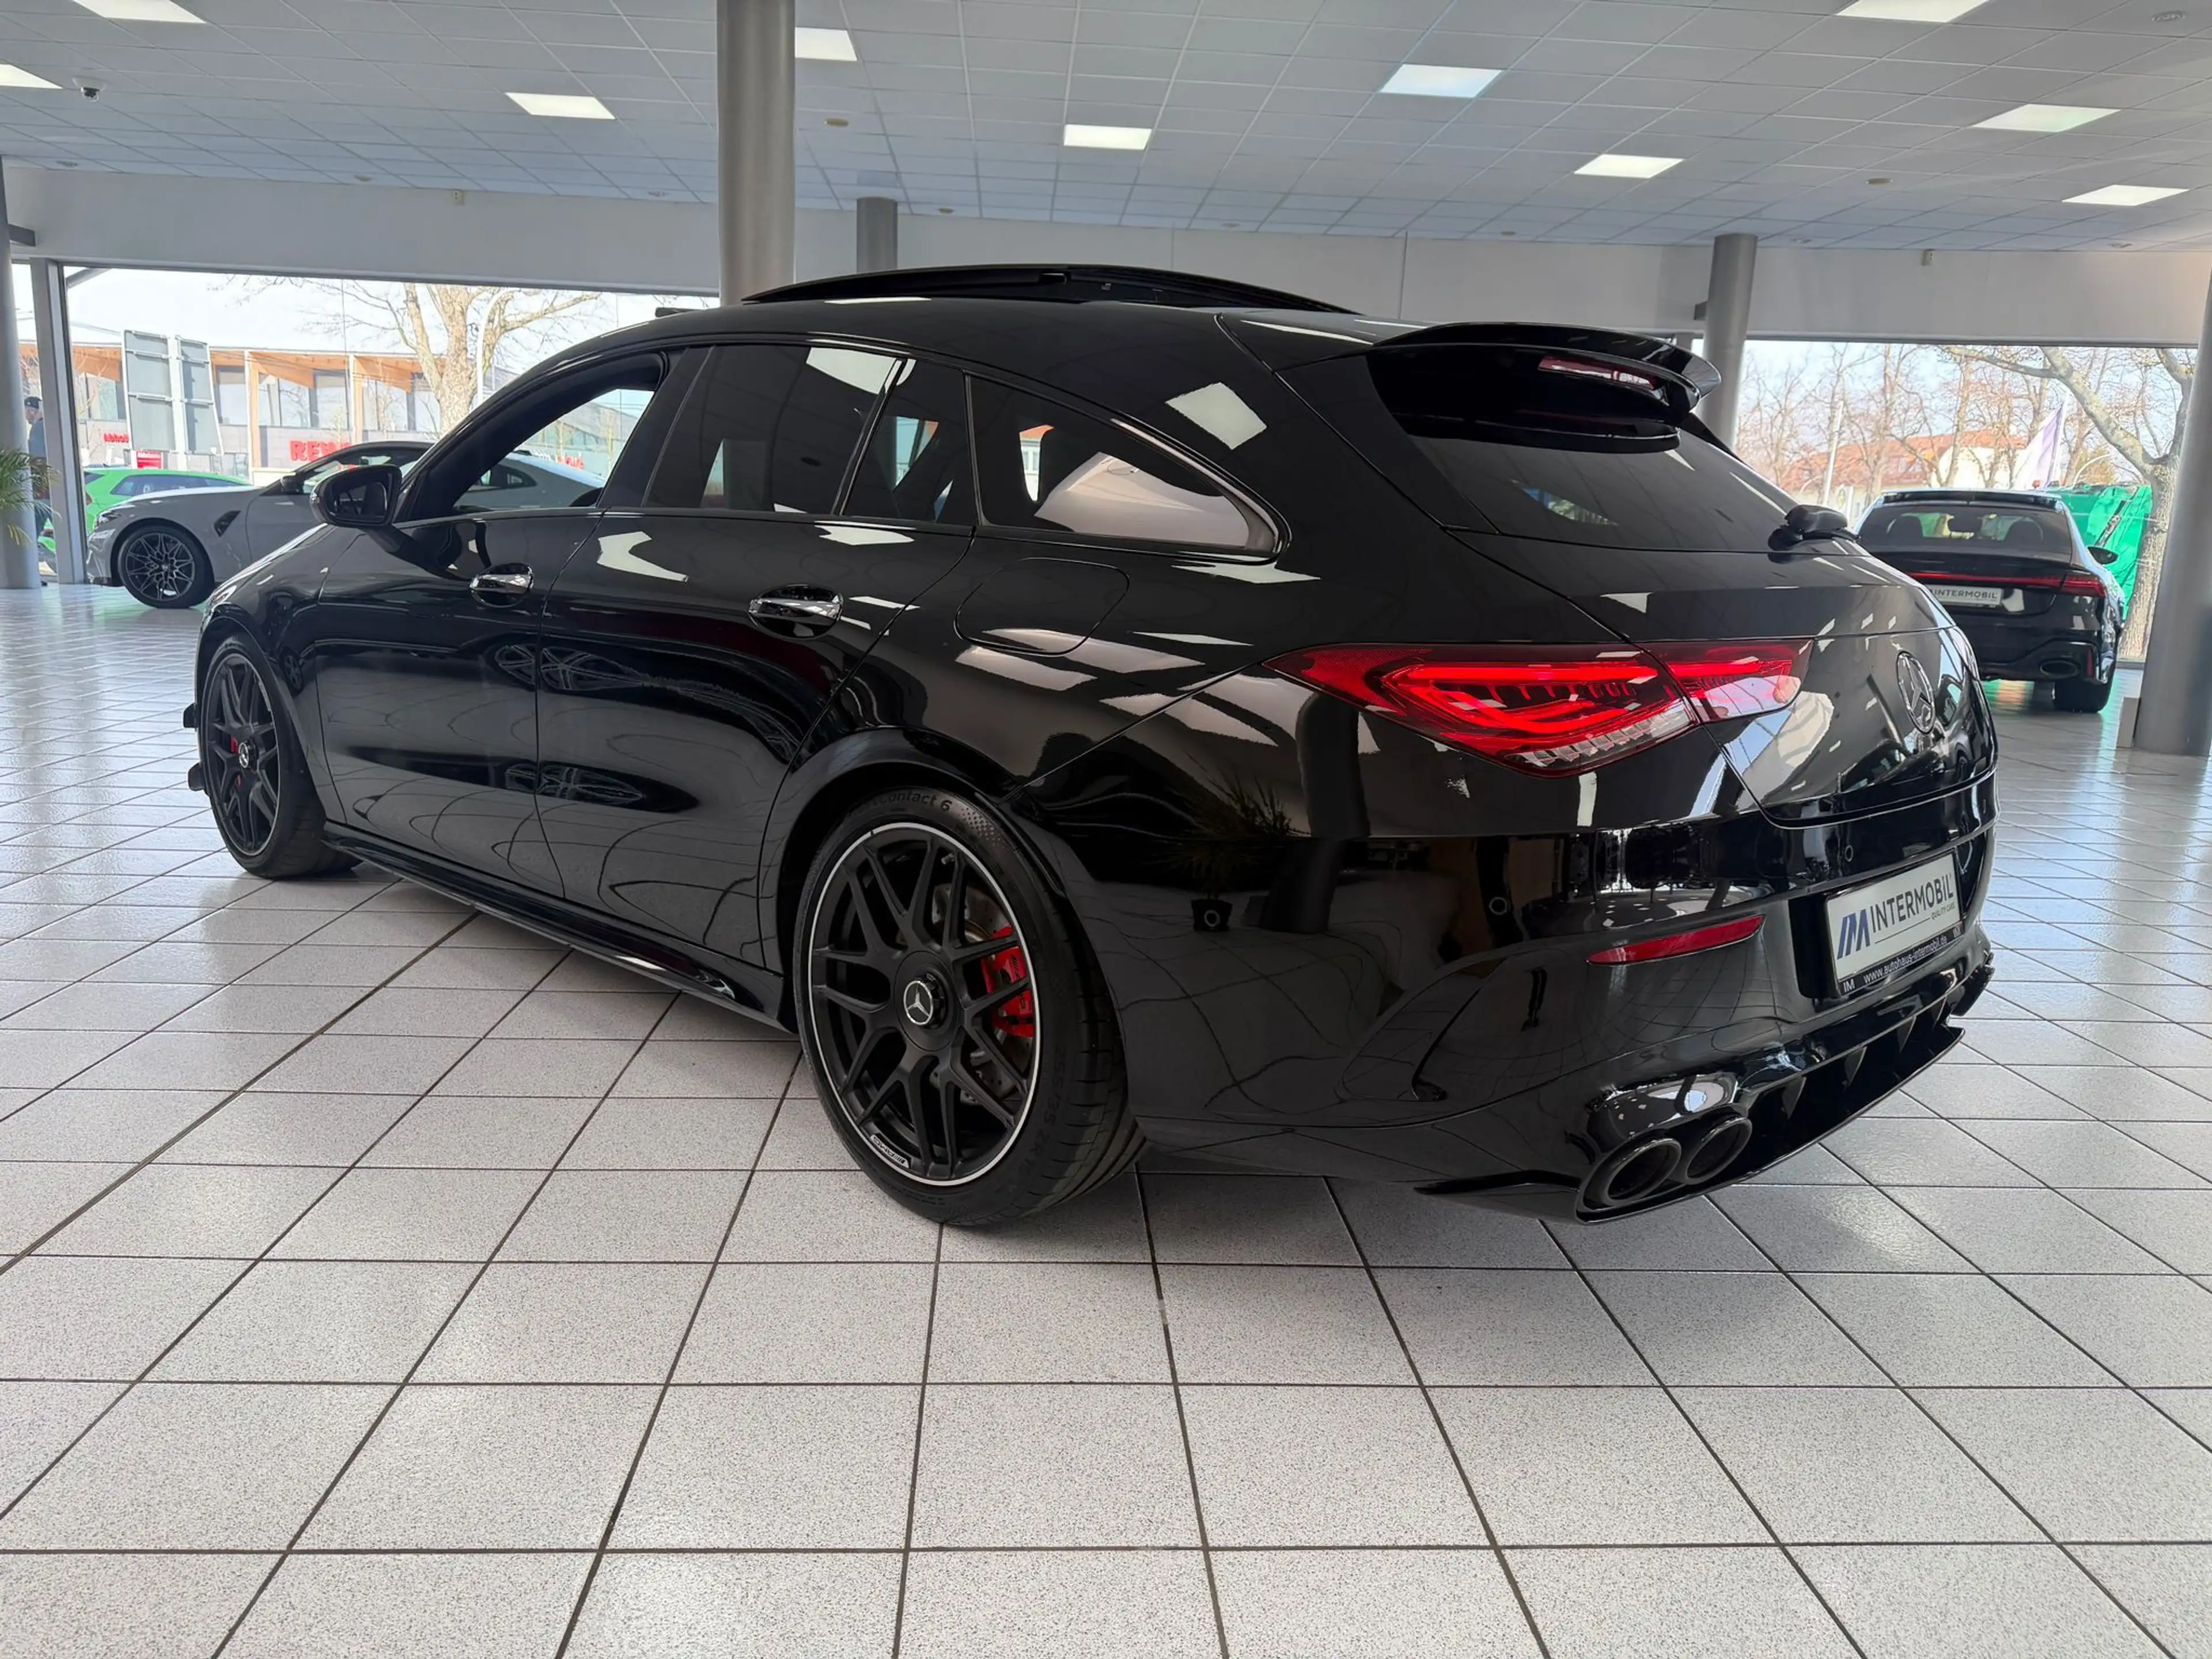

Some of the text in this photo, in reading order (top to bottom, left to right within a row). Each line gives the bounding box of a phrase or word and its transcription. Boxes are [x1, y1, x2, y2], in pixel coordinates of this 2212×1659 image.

[1934, 588, 1998, 599] INTERMOBIL
[940, 800, 952, 812] 6
[1870, 874, 1953, 933] INTERMOBIL
[1843, 979, 1855, 993] IM
[1863, 935, 1948, 984] www.autohaus-intermobil.de
